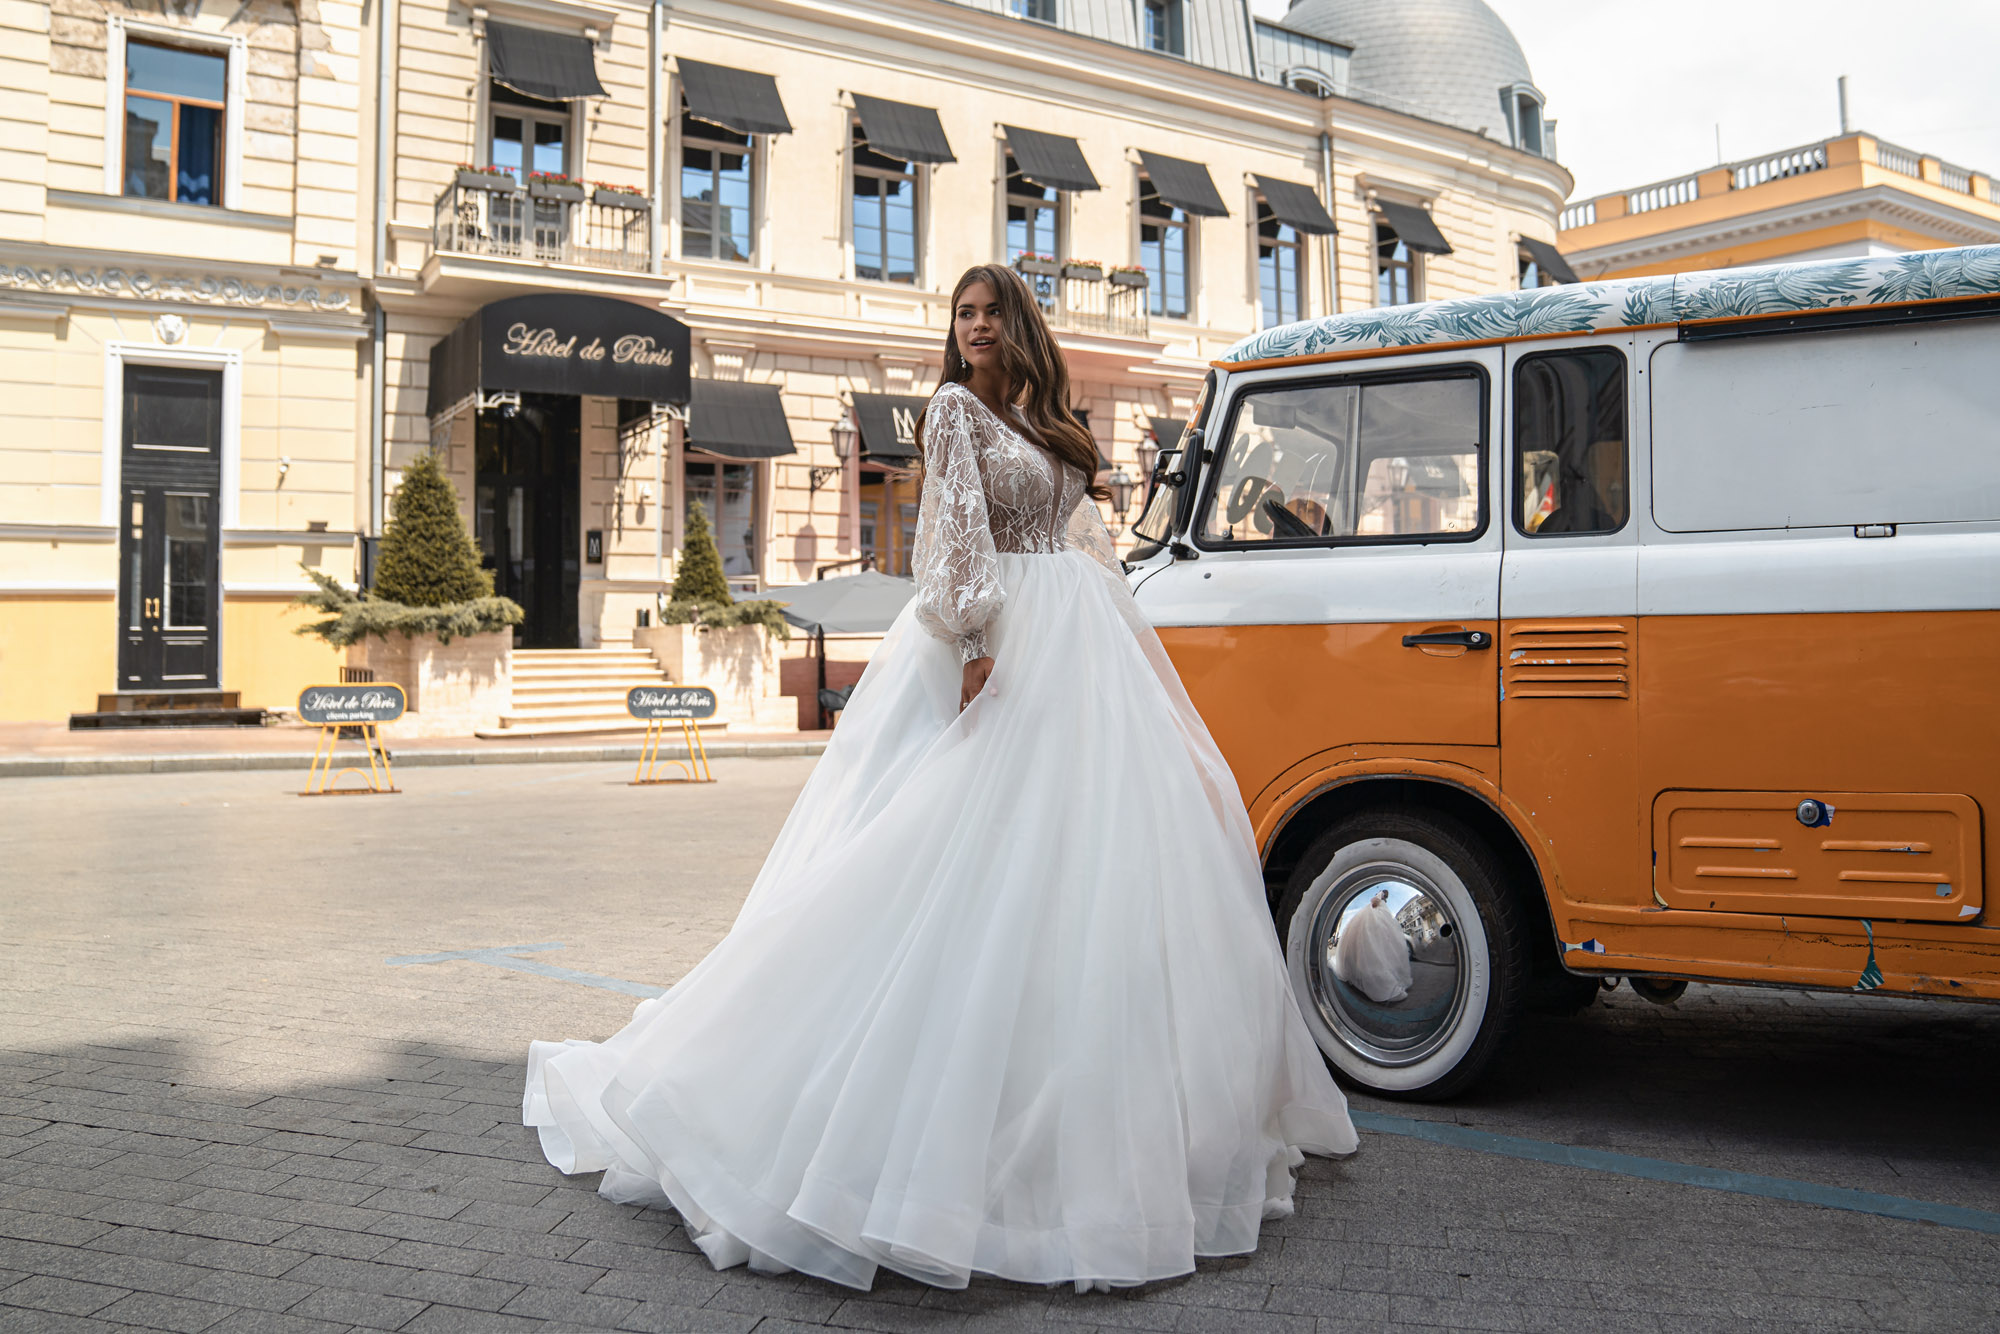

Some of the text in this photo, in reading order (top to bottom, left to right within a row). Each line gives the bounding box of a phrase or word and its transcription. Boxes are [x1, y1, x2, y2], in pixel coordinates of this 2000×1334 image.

[503, 322, 673, 366] Hôtel de Paris
[344, 695, 360, 710] de
[361, 691, 397, 709] Paris
[666, 694, 680, 707] de
[680, 691, 711, 708] Paris
[349, 711, 375, 721] parking
